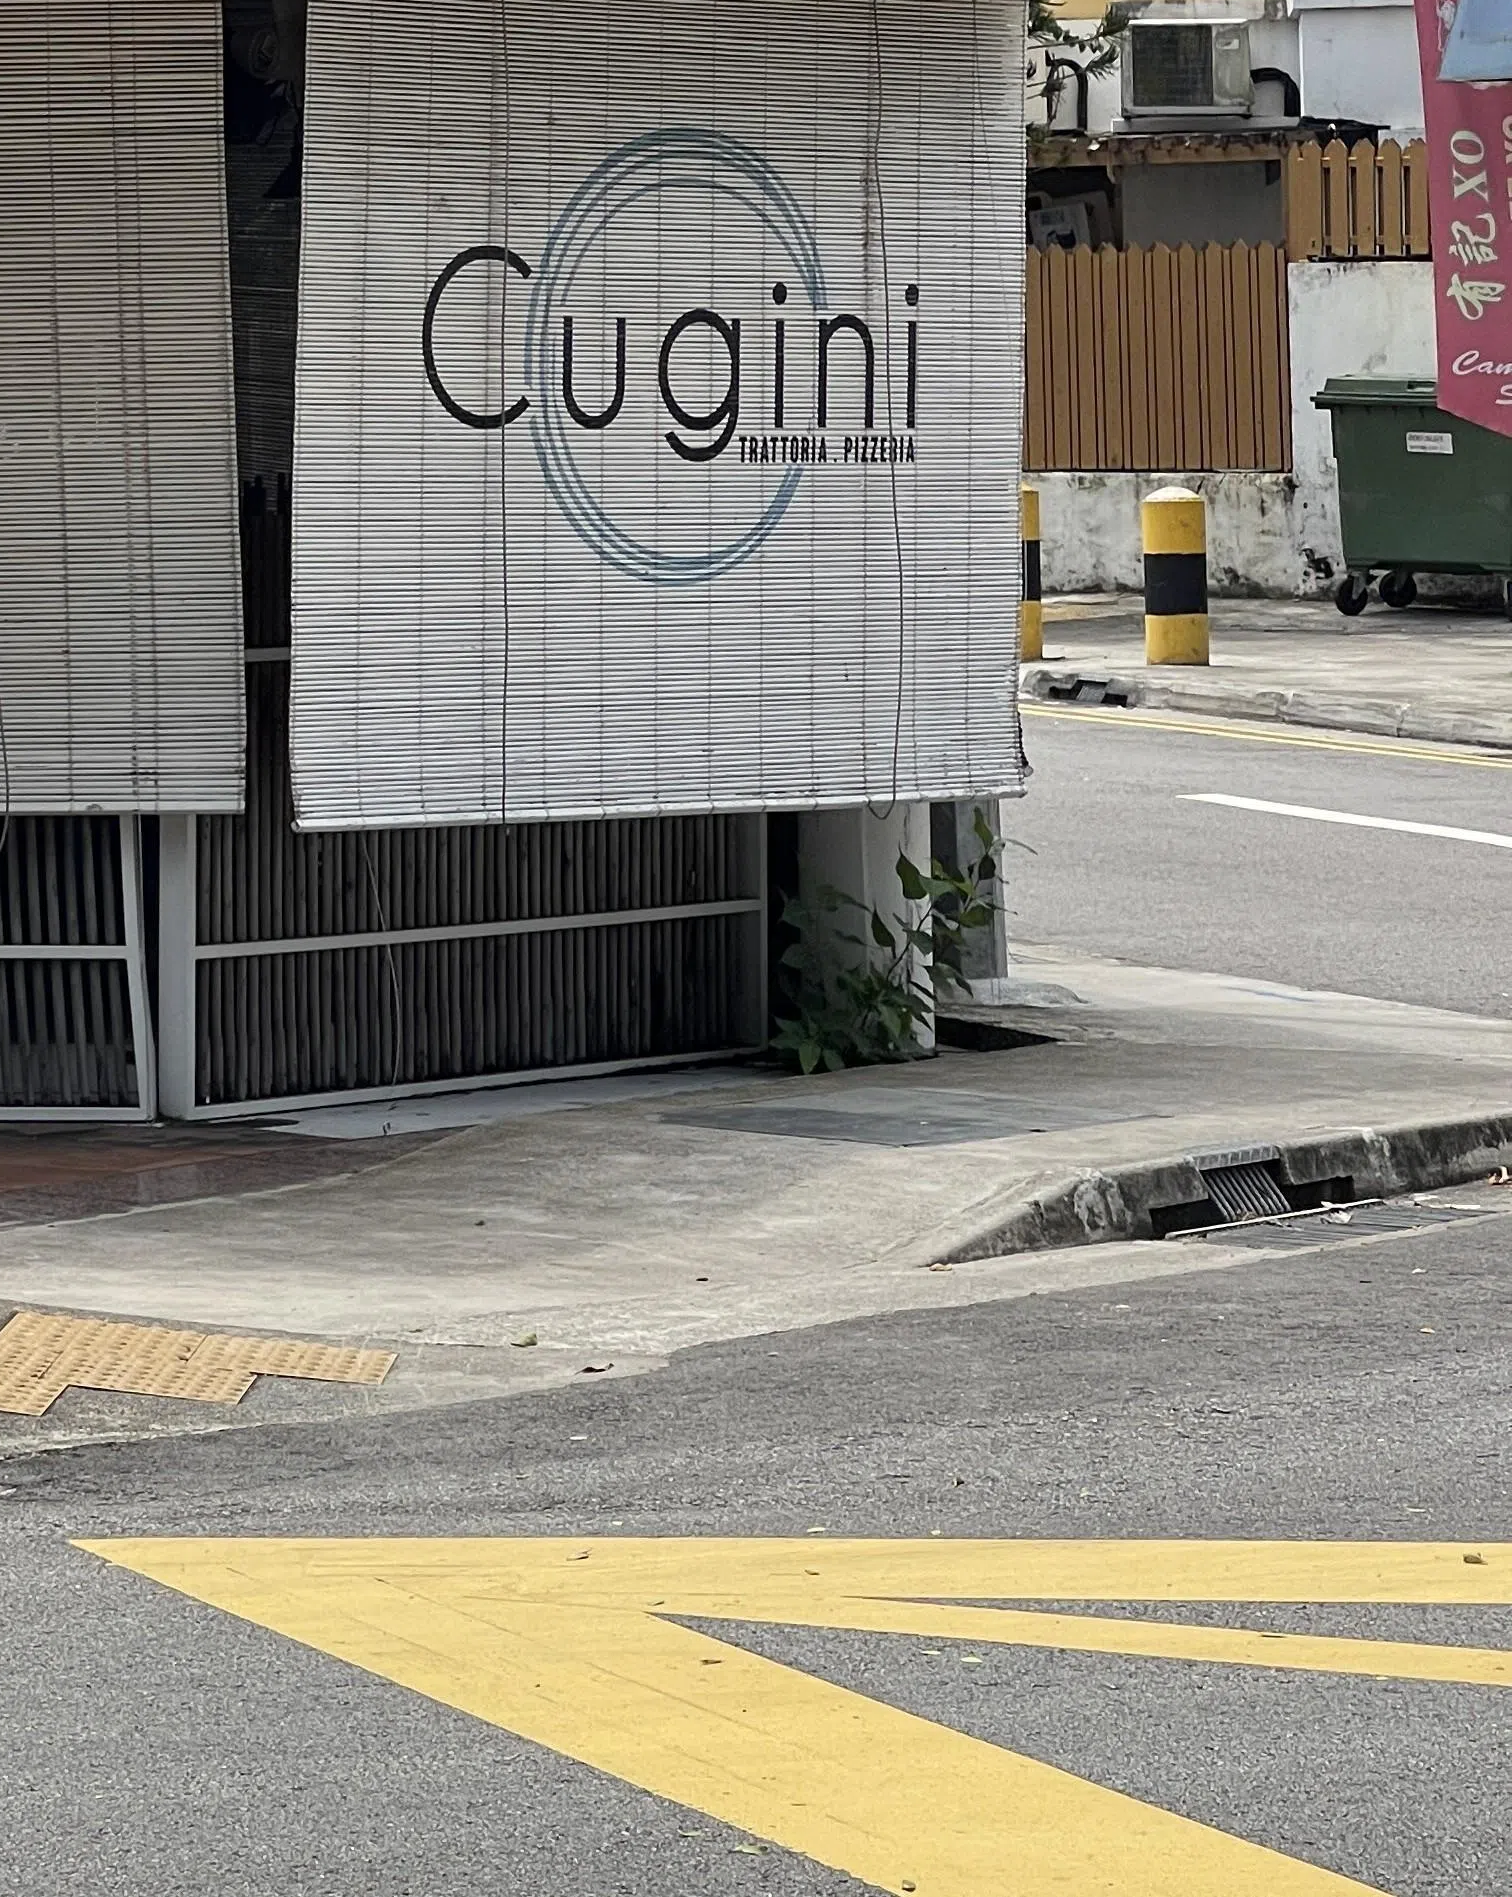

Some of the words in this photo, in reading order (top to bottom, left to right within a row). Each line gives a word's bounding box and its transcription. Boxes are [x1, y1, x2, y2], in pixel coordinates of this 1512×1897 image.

[1450, 130, 1489, 203] XO
[1446, 212, 1506, 321] 有記
[422, 245, 919, 462] Cugini
[738, 436, 827, 463] TRATTORIA
[843, 436, 915, 463] PIZZERIA
